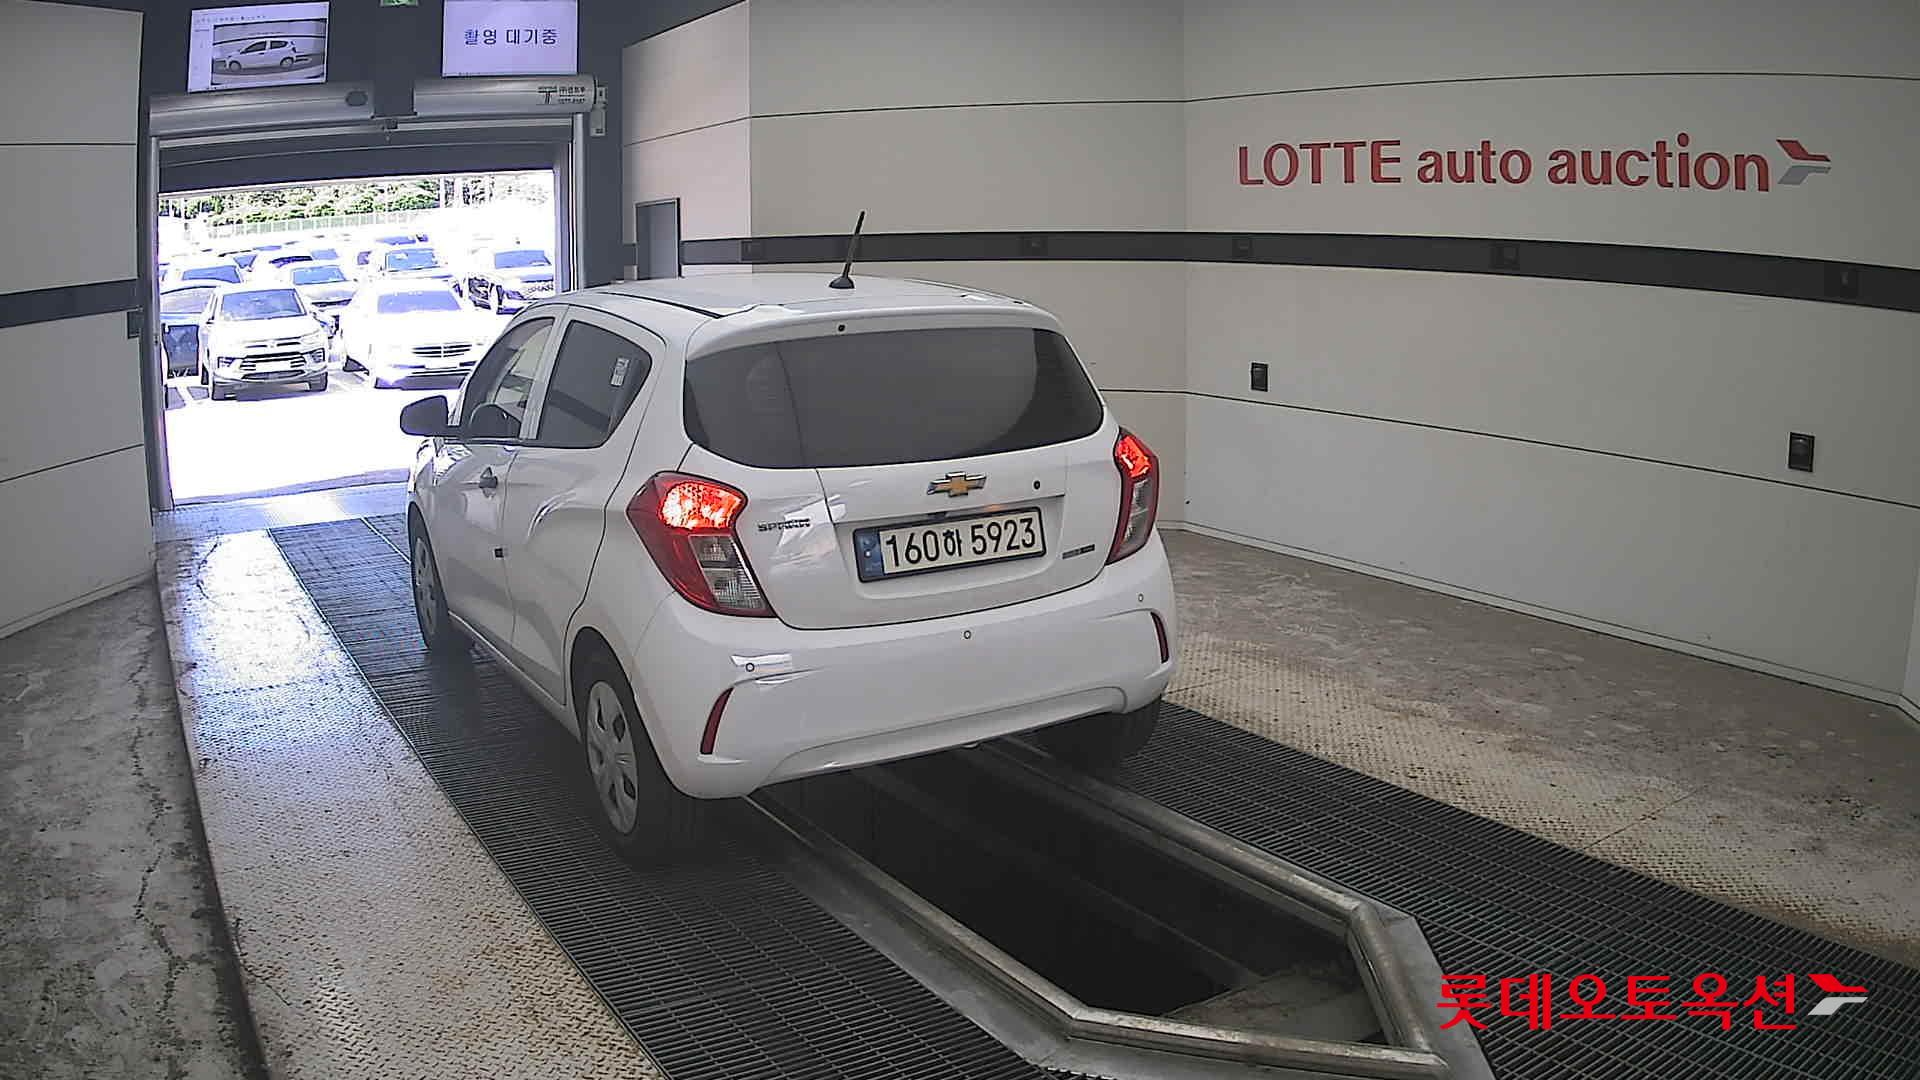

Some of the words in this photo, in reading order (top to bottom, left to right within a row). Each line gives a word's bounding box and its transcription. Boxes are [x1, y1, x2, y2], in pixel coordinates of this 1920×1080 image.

[505, 29, 557, 45] 대기중
[1239, 140, 1401, 186] LOTTE
[1417, 140, 1532, 184] auto
[1547, 132, 1769, 192] auction
[885, 529, 963, 567] 160하
[970, 517, 1036, 556] 5923
